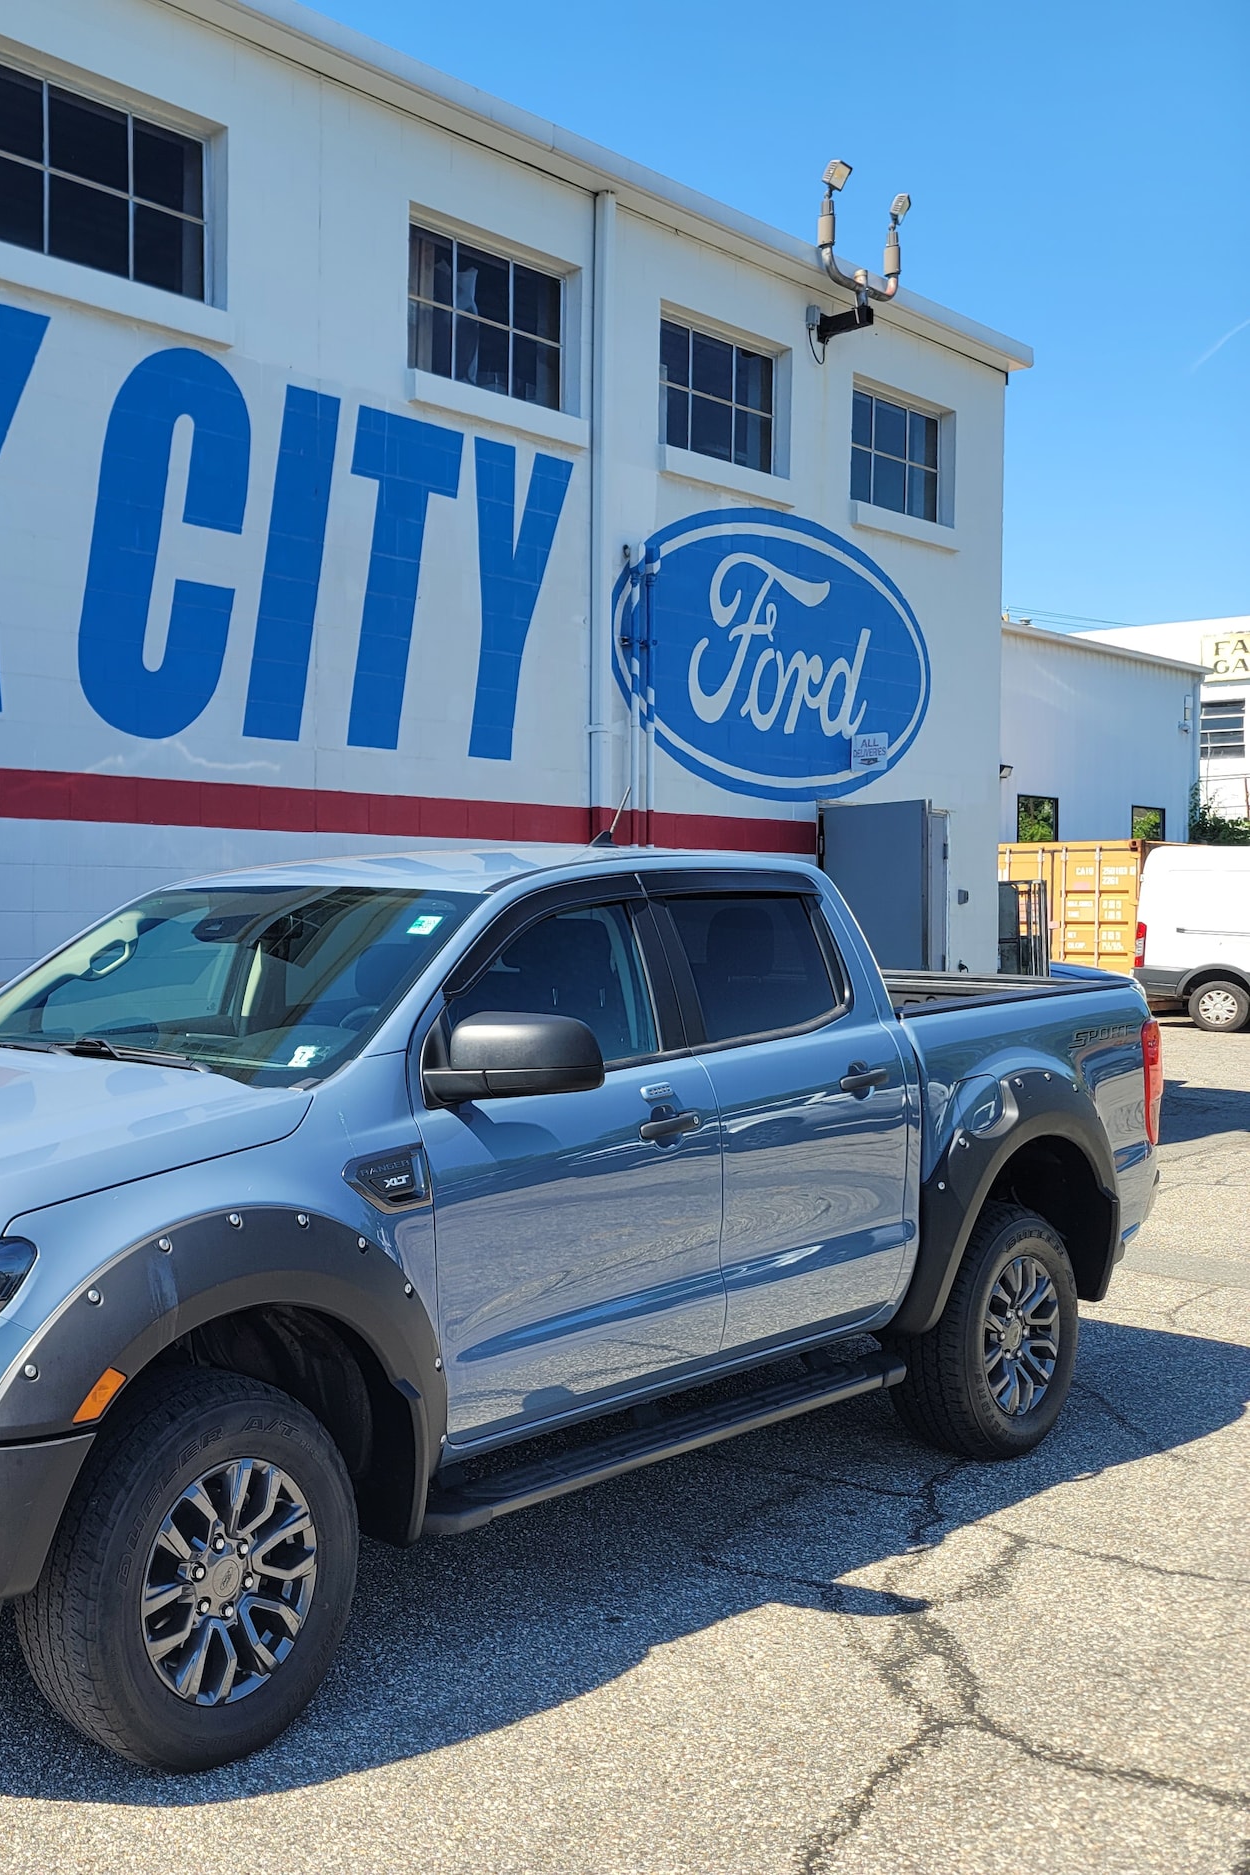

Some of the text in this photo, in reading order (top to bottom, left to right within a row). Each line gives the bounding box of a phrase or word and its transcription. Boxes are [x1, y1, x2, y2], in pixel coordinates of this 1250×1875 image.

[77, 346, 575, 761] CITY
[687, 551, 870, 740] Ford
[853, 747, 887, 758] DELIVERIES
[860, 737, 879, 748] ALL
[1068, 1024, 1134, 1049] SPORT
[360, 1159, 410, 1177] RANGER
[383, 1174, 410, 1188] XLT
[117, 1425, 224, 1588] DUELER
[240, 1415, 300, 1442] A/T
